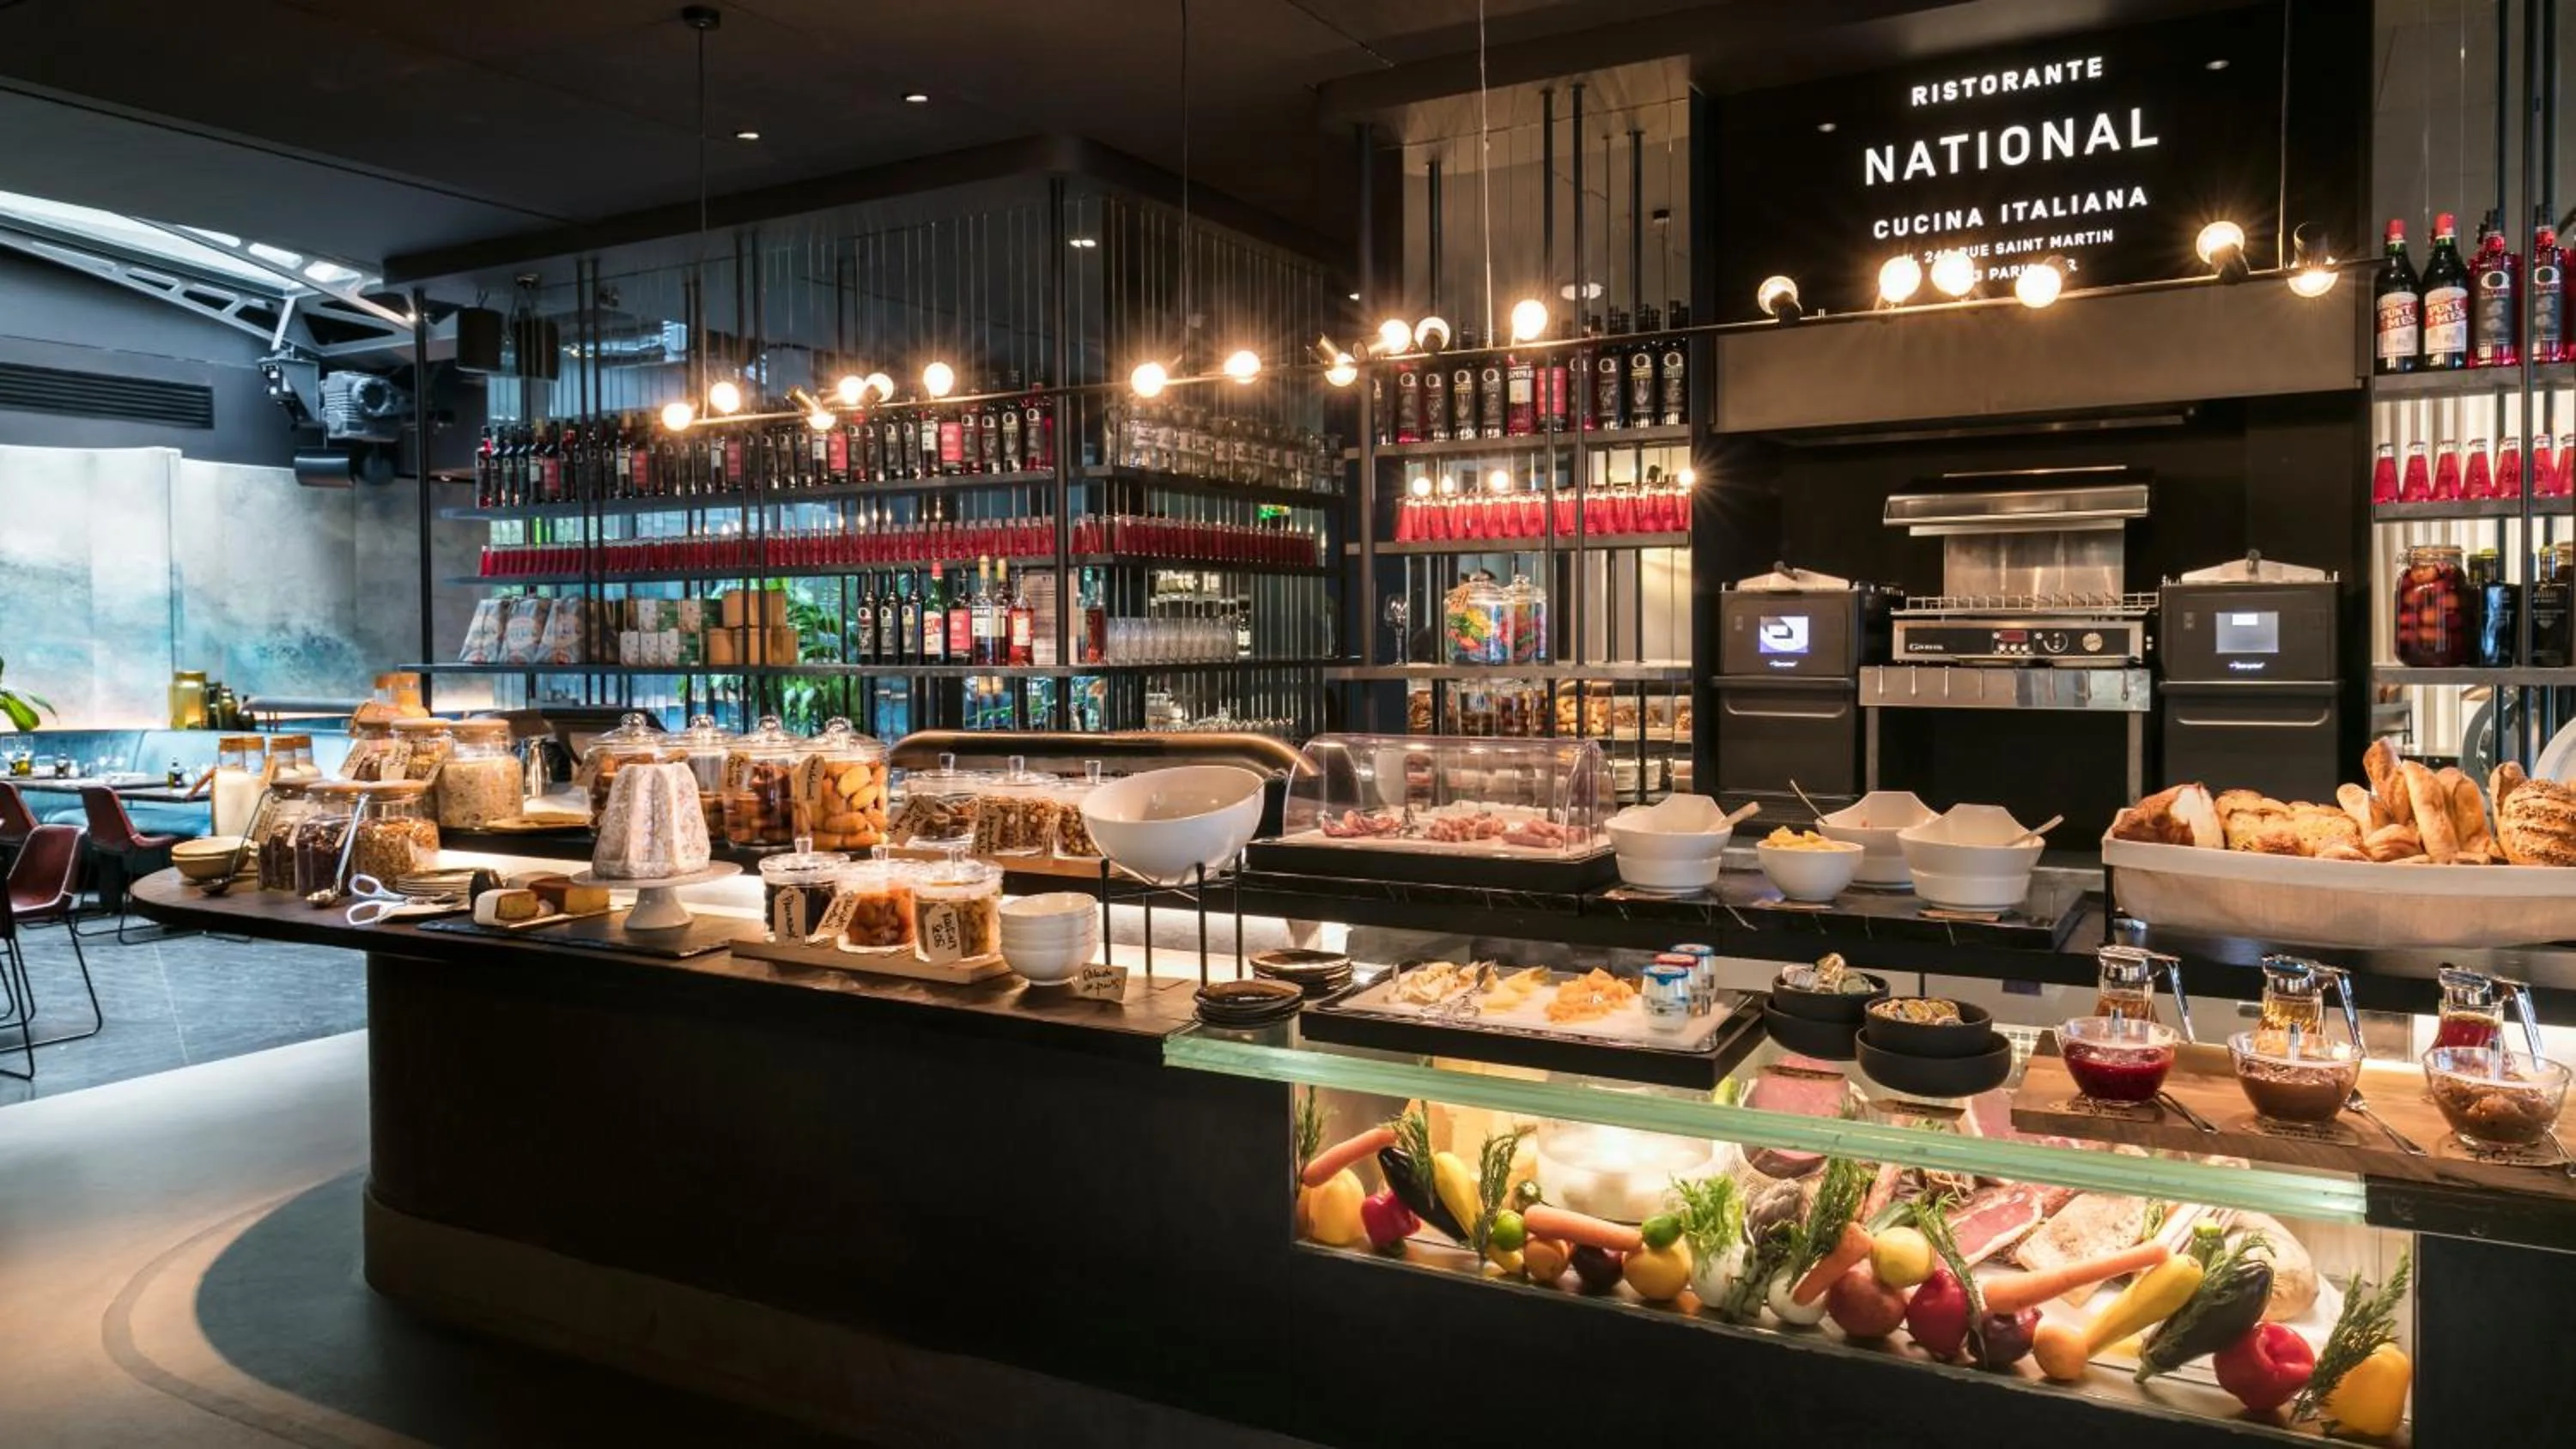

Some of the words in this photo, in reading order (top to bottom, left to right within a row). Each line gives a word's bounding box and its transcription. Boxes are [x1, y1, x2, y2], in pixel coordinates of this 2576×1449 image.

[1911, 56, 2104, 106] RISTORANTE
[1865, 107, 2159, 186] NATIONAL
[1873, 207, 1984, 239] CUCINA
[2001, 186, 2148, 224] ITALIANA
[1995, 237, 2044, 255] SAINT
[2050, 229, 2114, 249] MARTIN
